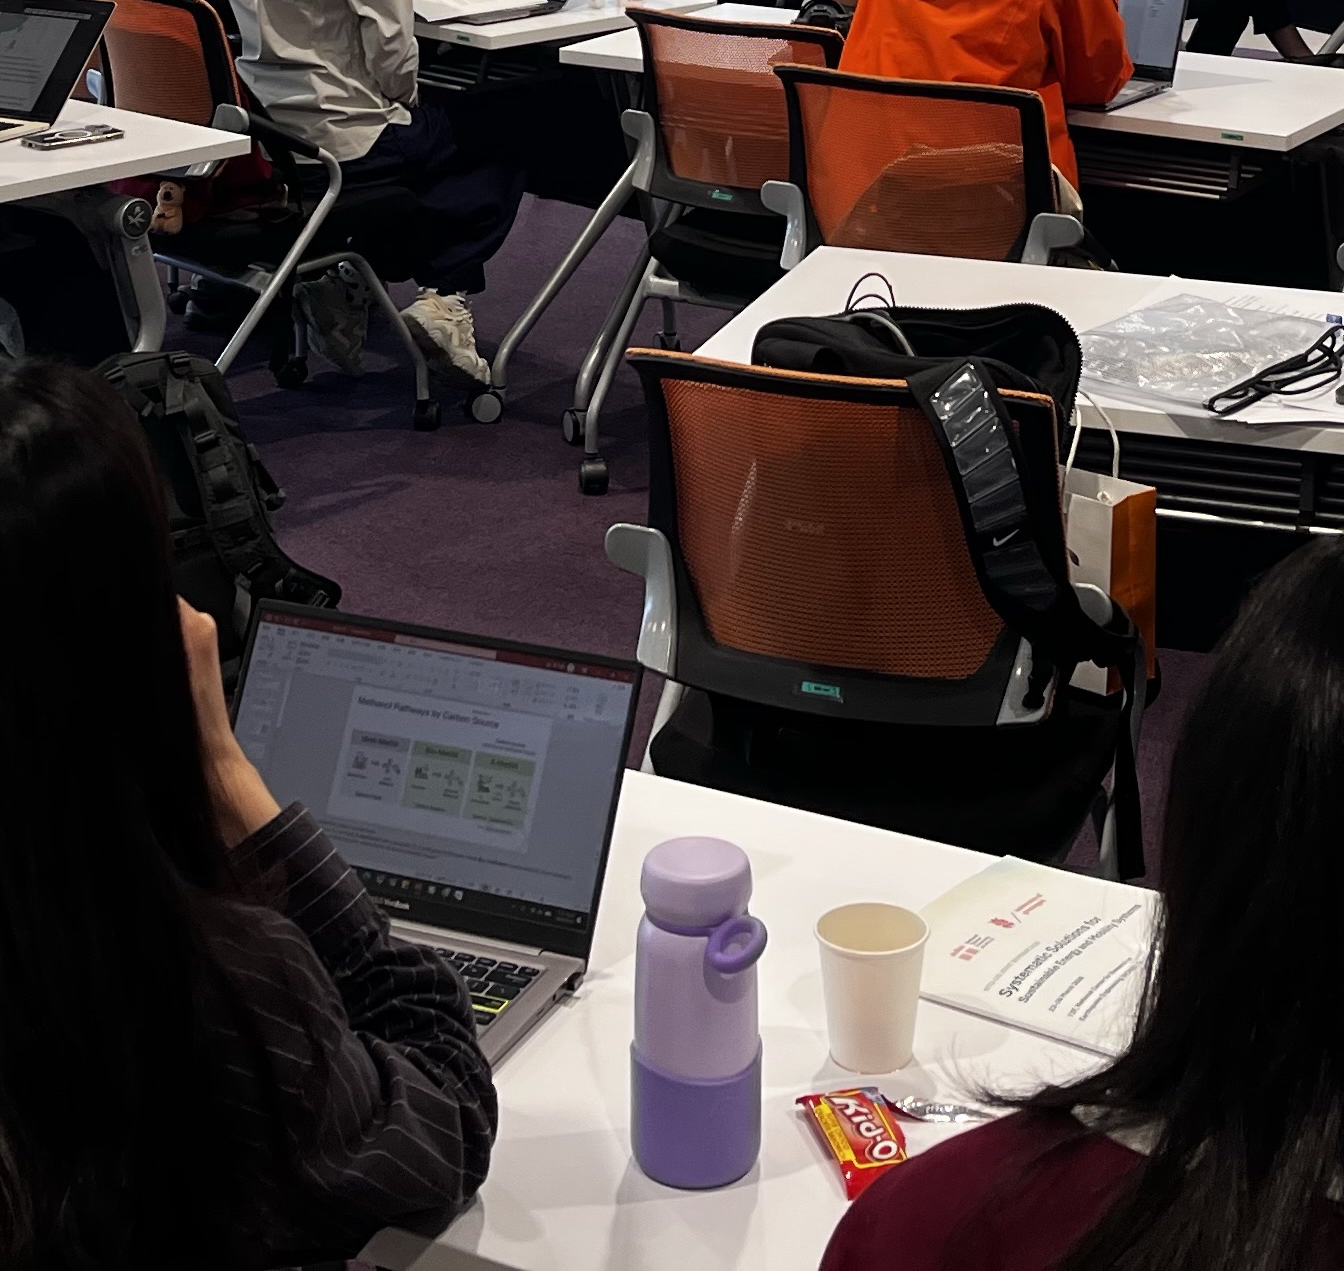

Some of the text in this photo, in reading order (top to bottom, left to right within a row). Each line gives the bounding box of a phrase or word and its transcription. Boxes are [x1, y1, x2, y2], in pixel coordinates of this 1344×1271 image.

[998, 950, 1053, 998] Systematic
[1046, 924, 1091, 953] Solutions
[829, 1096, 898, 1160] Kid-O
